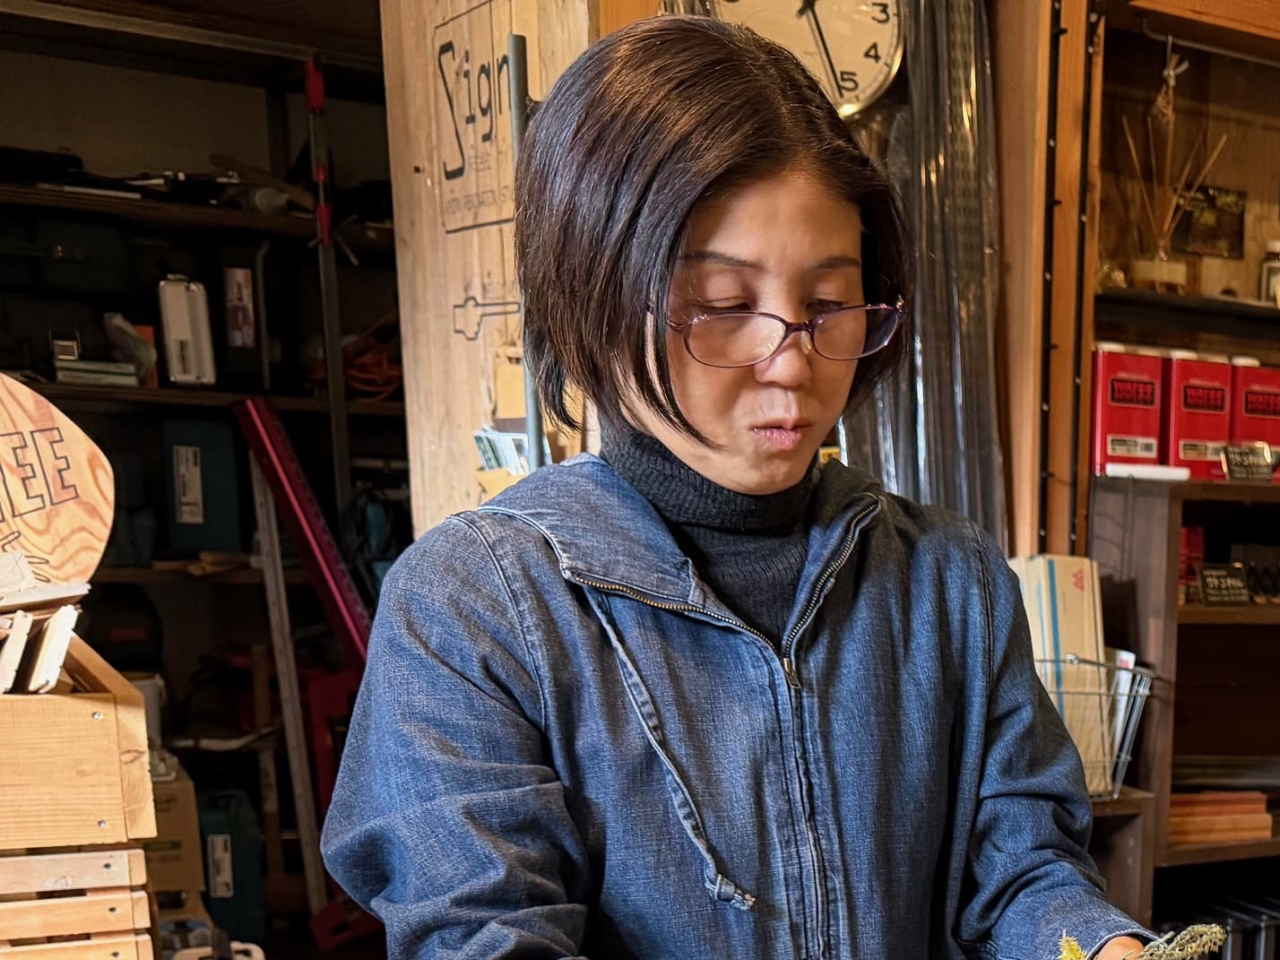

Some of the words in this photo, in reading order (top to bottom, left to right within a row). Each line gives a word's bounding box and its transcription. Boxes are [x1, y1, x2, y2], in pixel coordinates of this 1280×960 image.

[871, 2, 890, 24] 3
[863, 42, 882, 64] 4
[840, 71, 858, 92] 5
[0, 427, 79, 523] EE
